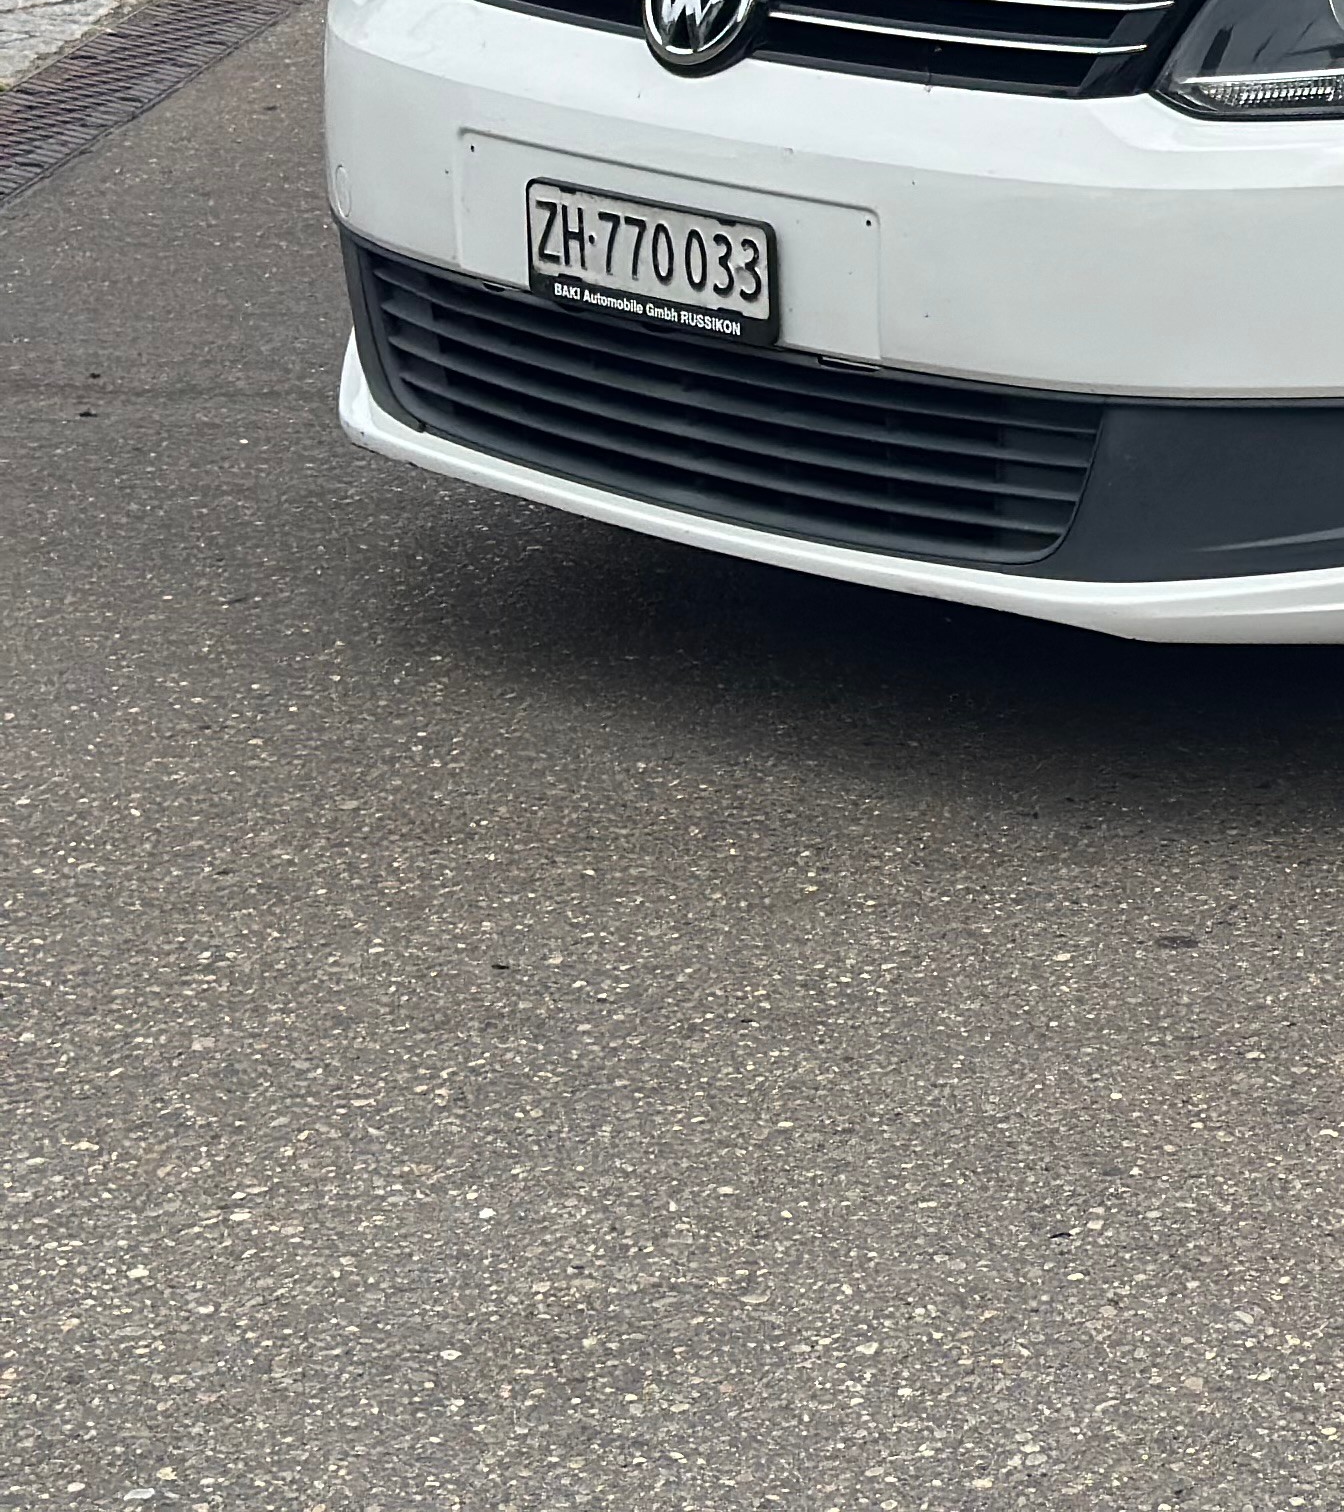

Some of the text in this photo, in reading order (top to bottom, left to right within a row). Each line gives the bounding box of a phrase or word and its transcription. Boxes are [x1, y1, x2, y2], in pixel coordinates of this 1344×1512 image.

[554, 283, 581, 300] BAKI
[583, 289, 644, 315] Automobile
[680, 311, 741, 336] RUSSIKON
